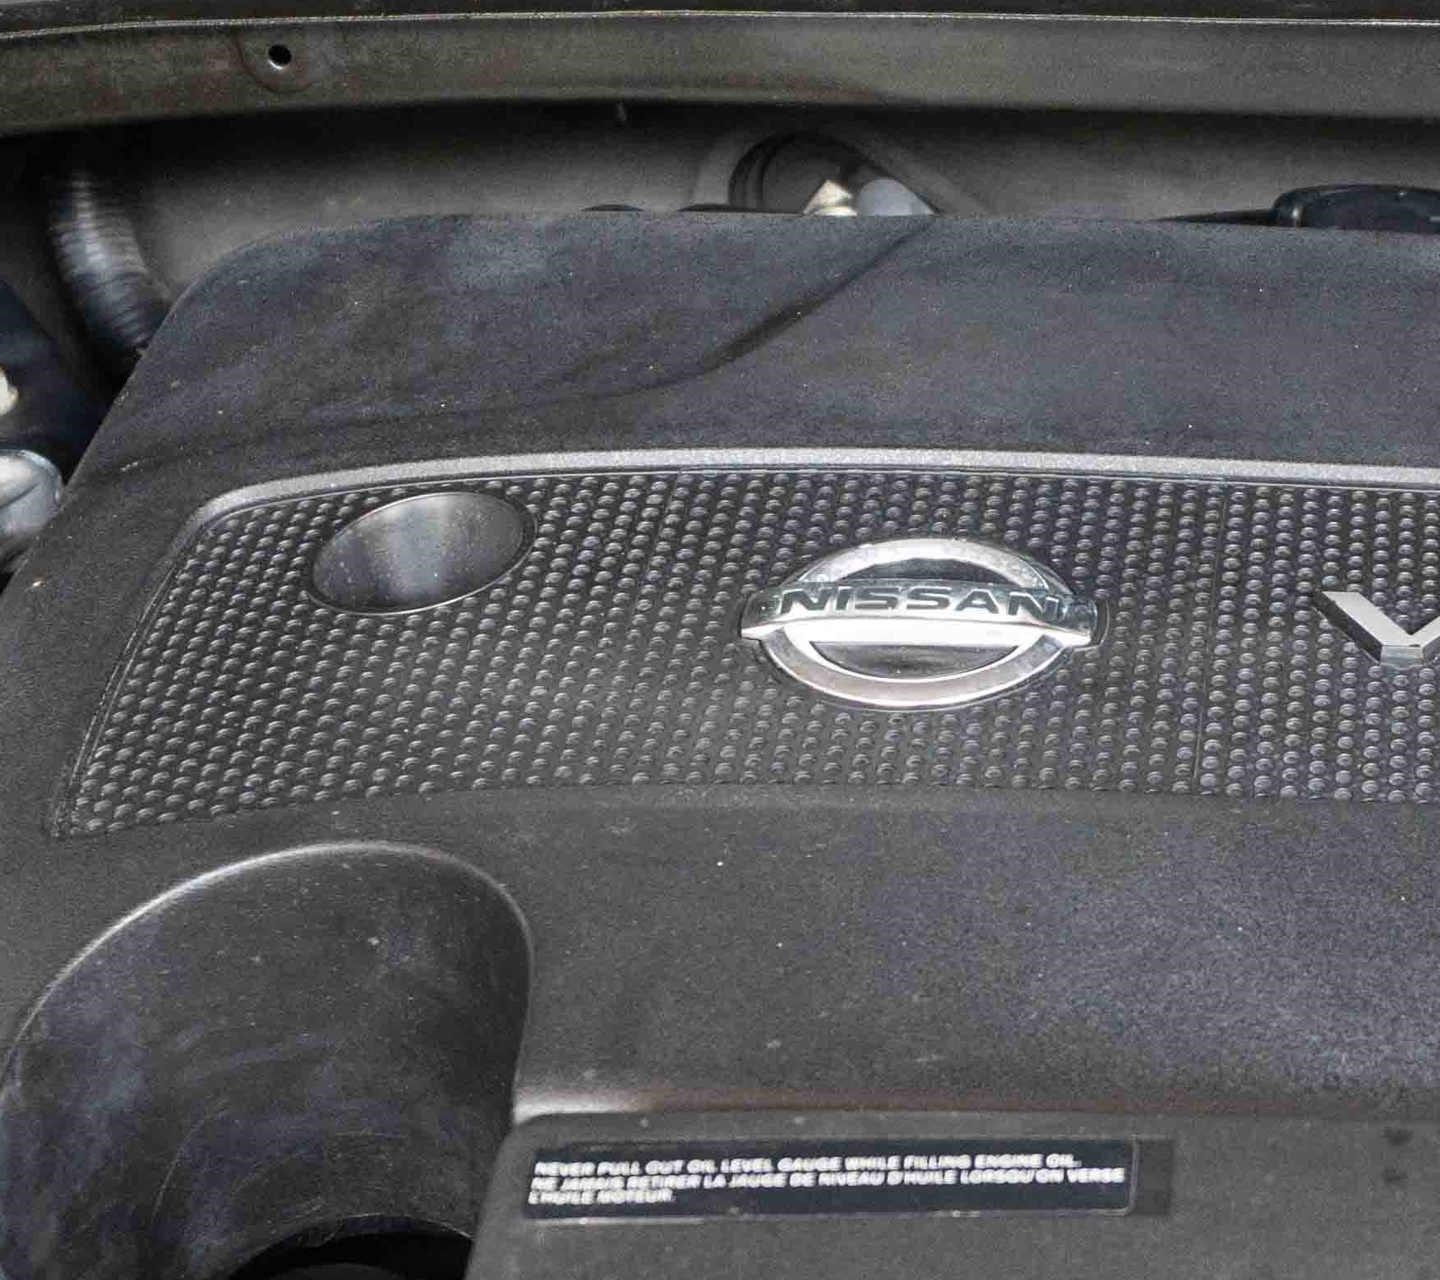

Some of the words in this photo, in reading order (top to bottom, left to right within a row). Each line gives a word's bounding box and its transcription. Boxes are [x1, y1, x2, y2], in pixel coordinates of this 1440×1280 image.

[774, 579, 1062, 620] NISSAN
[534, 1161, 595, 1176] NEVER
[597, 1161, 640, 1176] PULL
[645, 1159, 684, 1175] OUT
[687, 1158, 716, 1174] OIL
[721, 1157, 773, 1174] LEVEL
[777, 1156, 843, 1172] GAUGE
[844, 1155, 900, 1170] WHILE
[903, 1154, 972, 1170] FILLING
[974, 1153, 1043, 1169] ENGINE
[531, 1175, 558, 1191] NE
[560, 1175, 625, 1191] JAMAIS
[703, 1173, 727, 1189] LA
[728, 1172, 788, 1189] JAUGE
[789, 1171, 817, 1187] DE
[818, 1170, 885, 1187] NIVEAU
[1067, 1167, 1125, 1183] VERSE
